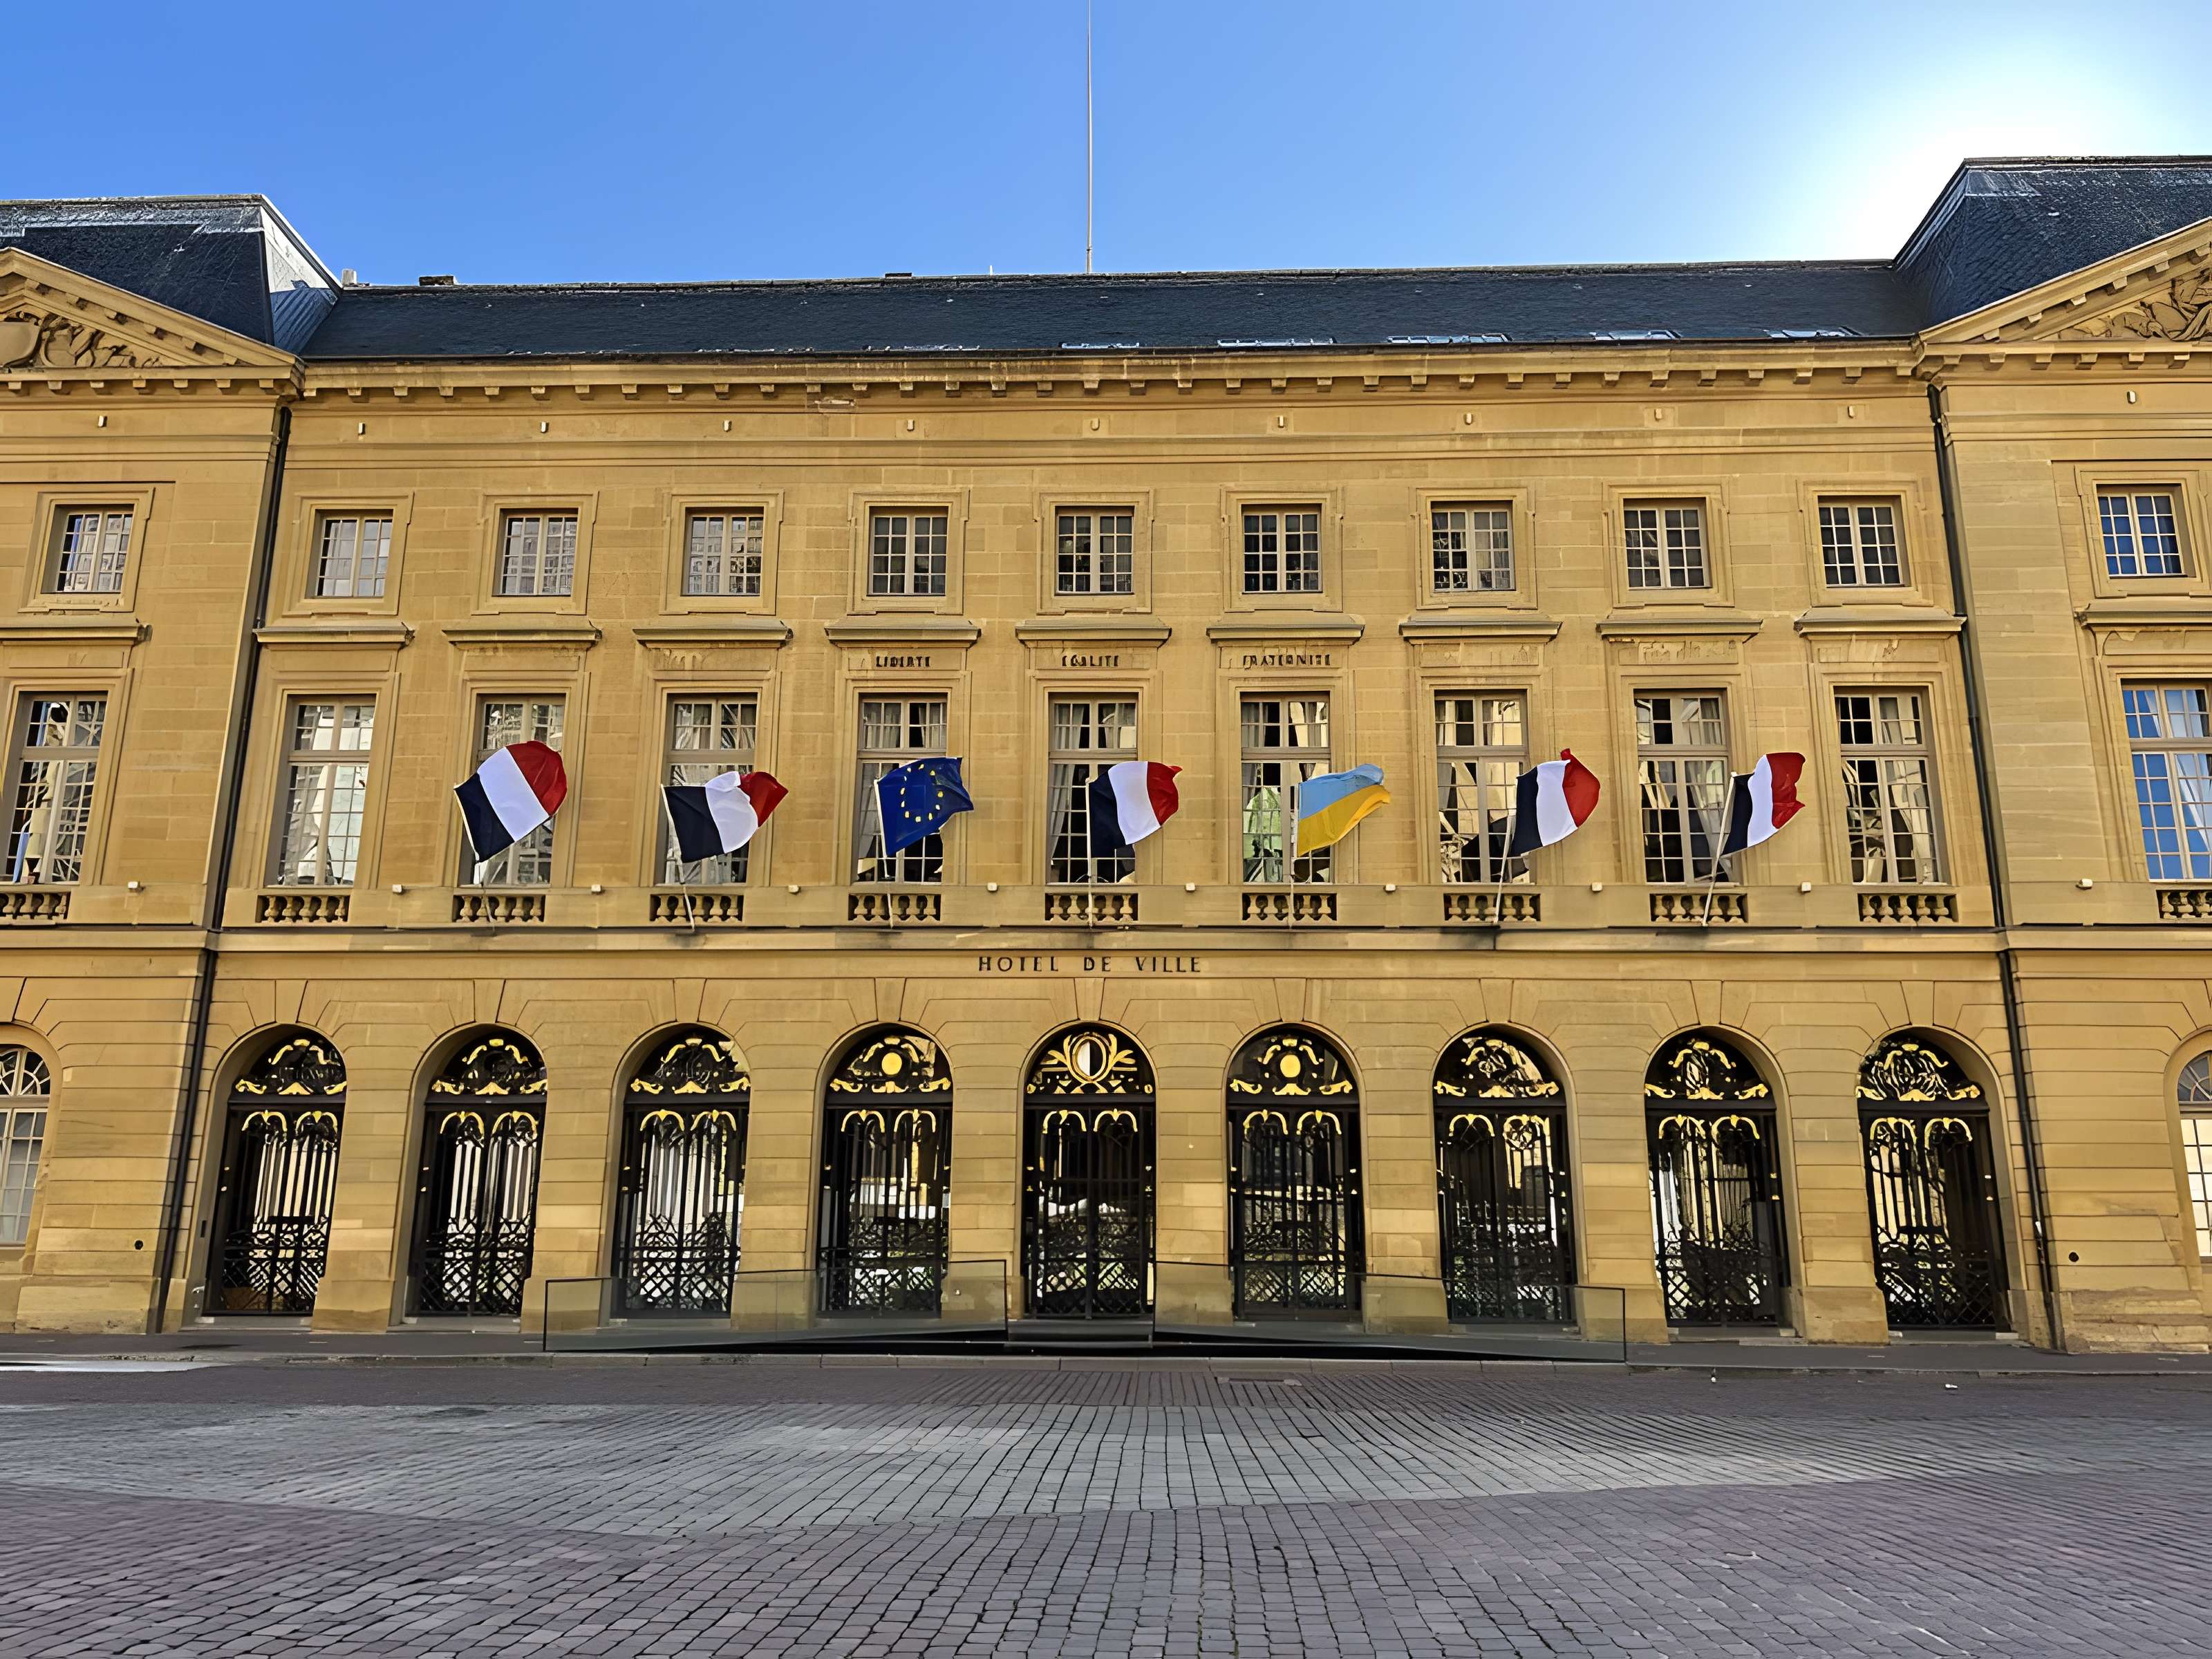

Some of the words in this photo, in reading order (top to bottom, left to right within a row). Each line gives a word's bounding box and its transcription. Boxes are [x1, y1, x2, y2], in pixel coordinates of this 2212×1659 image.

[978, 956, 1059, 972] HOTEL
[1083, 956, 1112, 972] DE
[1135, 956, 1201, 973] VILLE
